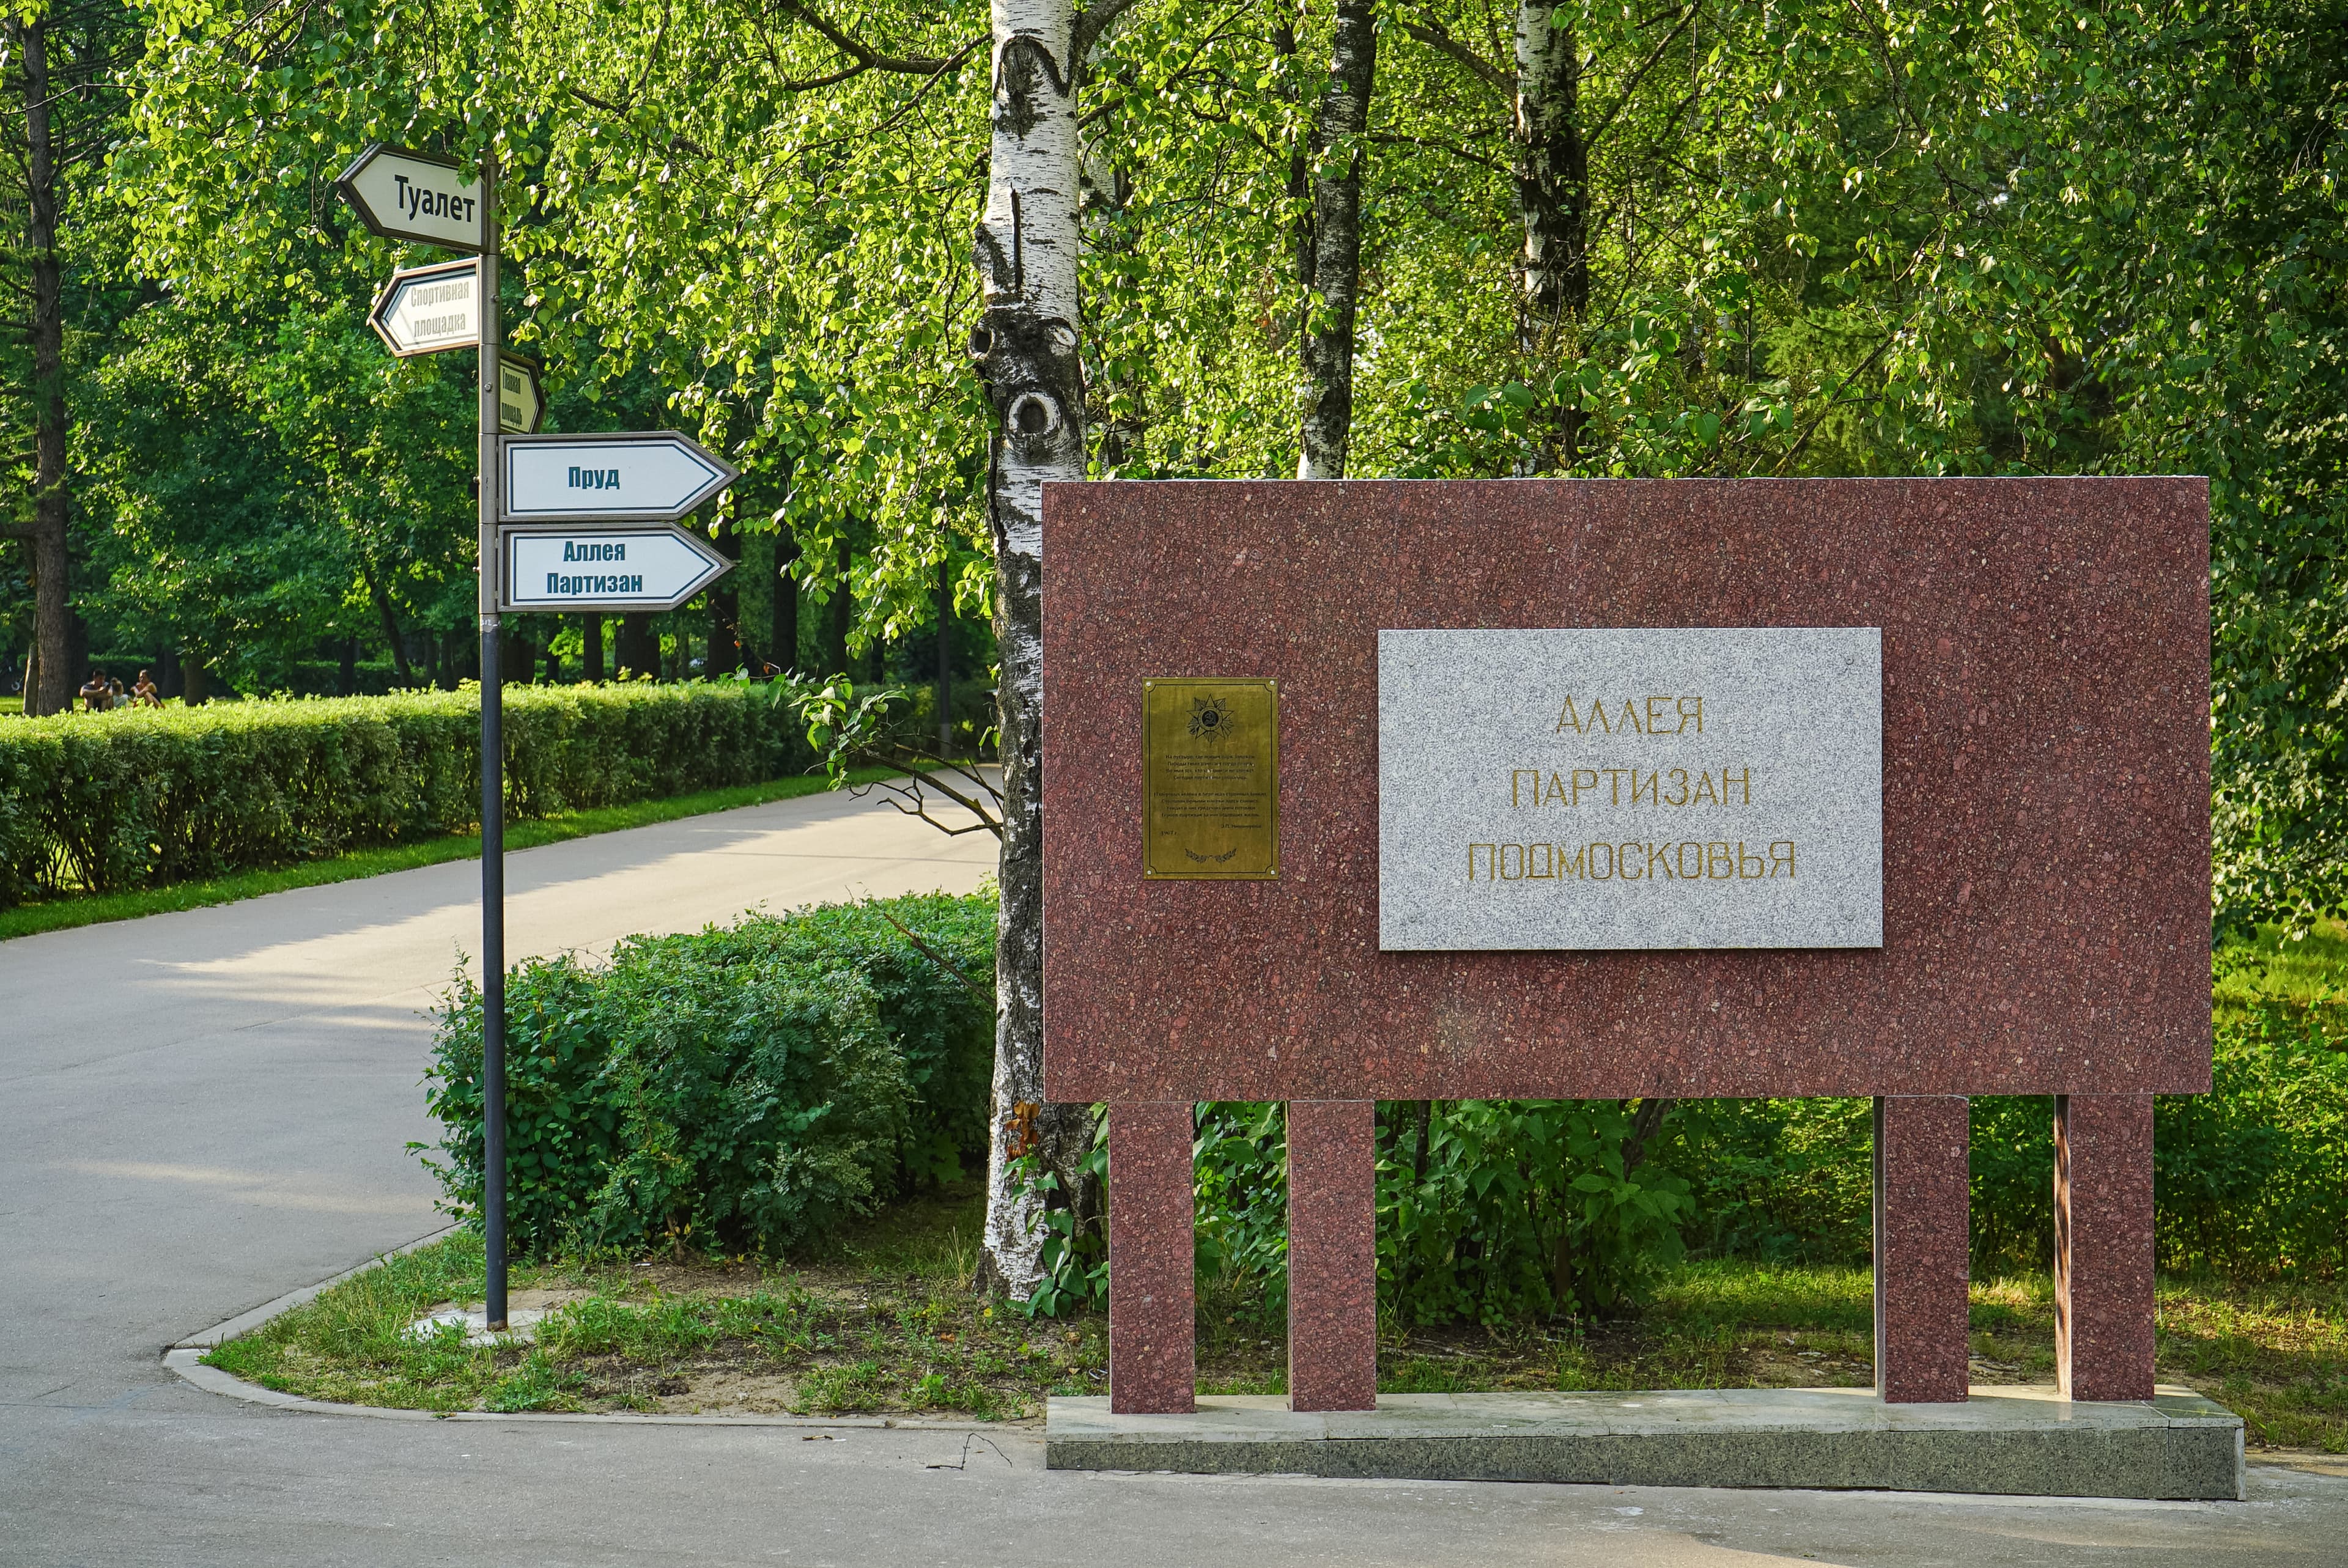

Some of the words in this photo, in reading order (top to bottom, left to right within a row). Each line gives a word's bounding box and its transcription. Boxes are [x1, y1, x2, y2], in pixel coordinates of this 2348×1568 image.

[394, 174, 475, 223] Туалет
[411, 281, 469, 307] Спортивная
[414, 313, 466, 337] площадка
[568, 466, 619, 490] Пруд
[563, 540, 625, 562] Аллея
[547, 572, 642, 596] Партизан
[1556, 694, 1703, 734] АЛЛЕЯ
[1512, 768, 1750, 807] ПАРТИЗАН
[1468, 841, 1795, 881] ПОДМОСКОВЬЯ
